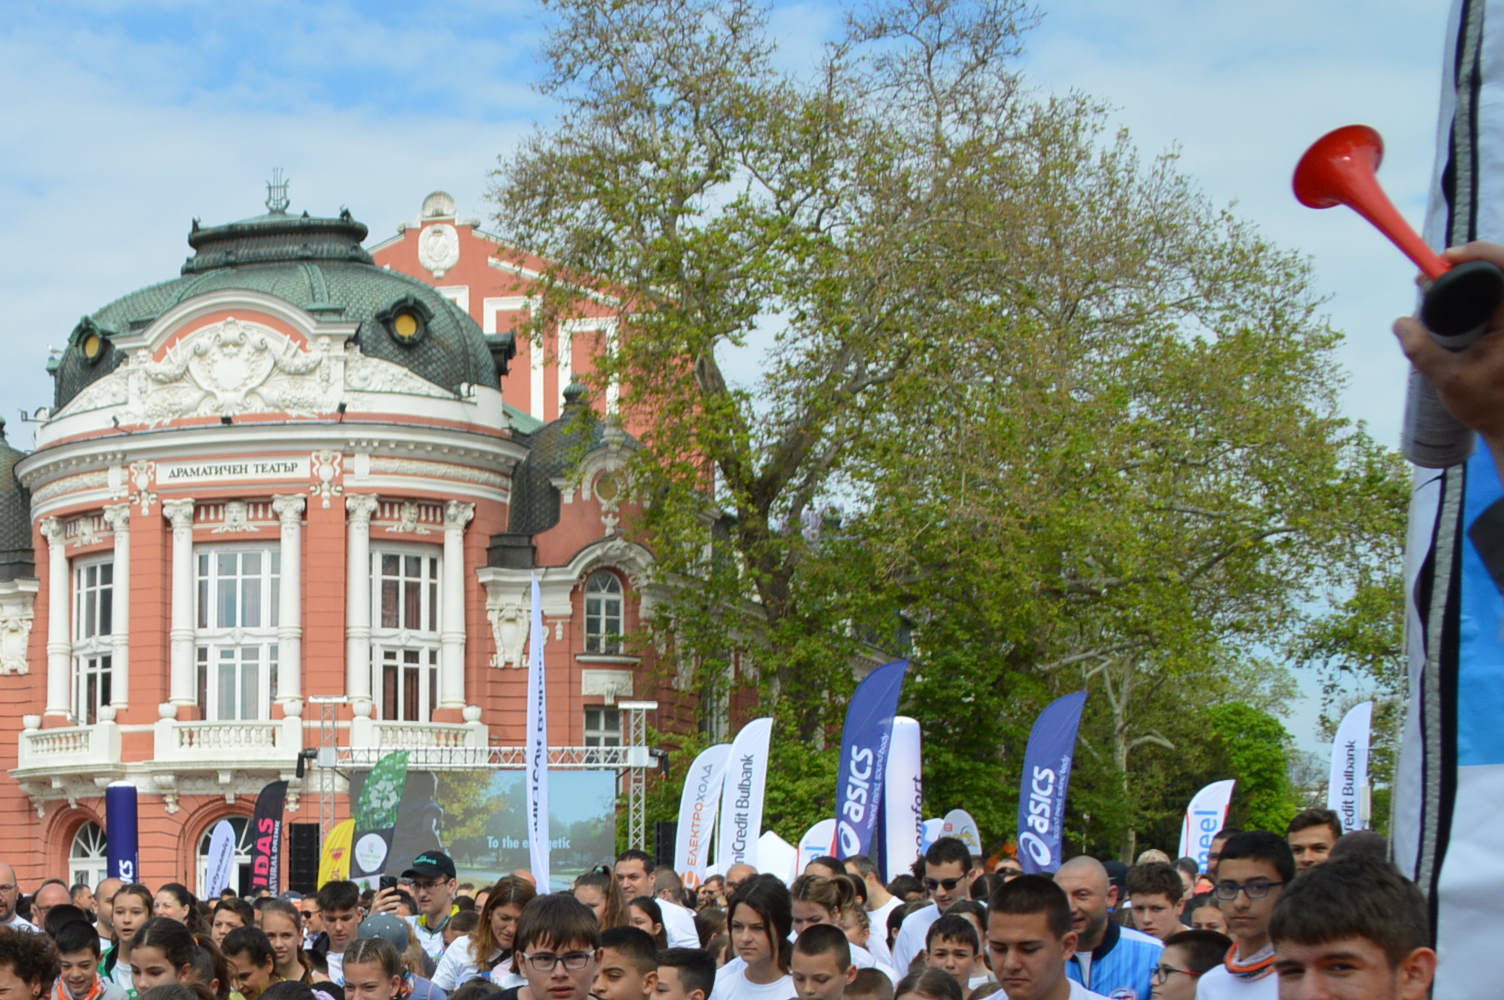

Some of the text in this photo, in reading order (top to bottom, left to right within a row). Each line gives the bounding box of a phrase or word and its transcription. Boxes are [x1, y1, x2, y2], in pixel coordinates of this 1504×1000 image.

[168, 462, 299, 479] ДРАМАТИЧЕН ТЕАТЪР
[731, 754, 755, 865] niCredit Bulbank
[1340, 739, 1356, 832] redit Bulbank
[252, 817, 275, 889] IDAS
[487, 836, 499, 849] To
[502, 836, 519, 849] the
